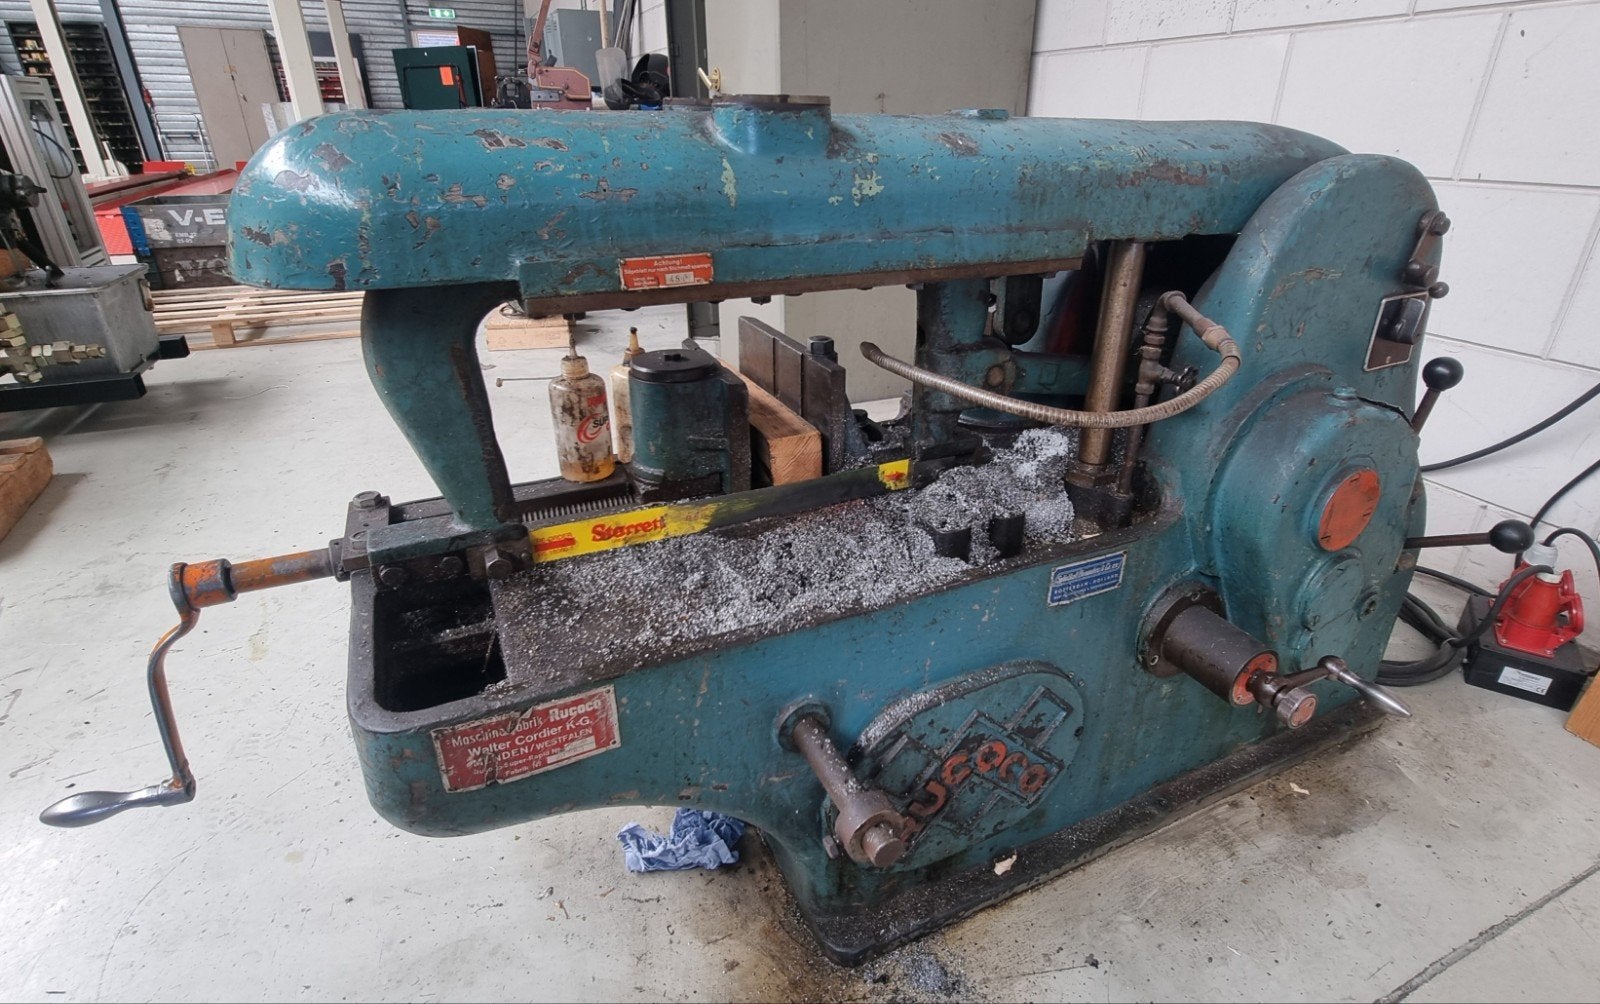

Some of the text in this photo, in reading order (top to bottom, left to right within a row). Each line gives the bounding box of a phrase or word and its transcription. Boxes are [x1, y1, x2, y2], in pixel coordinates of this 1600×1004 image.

[591, 513, 668, 542] Starrett
[549, 699, 603, 722] Rucoco
[468, 740, 511, 758] Walter
[515, 727, 563, 746] Cordier
